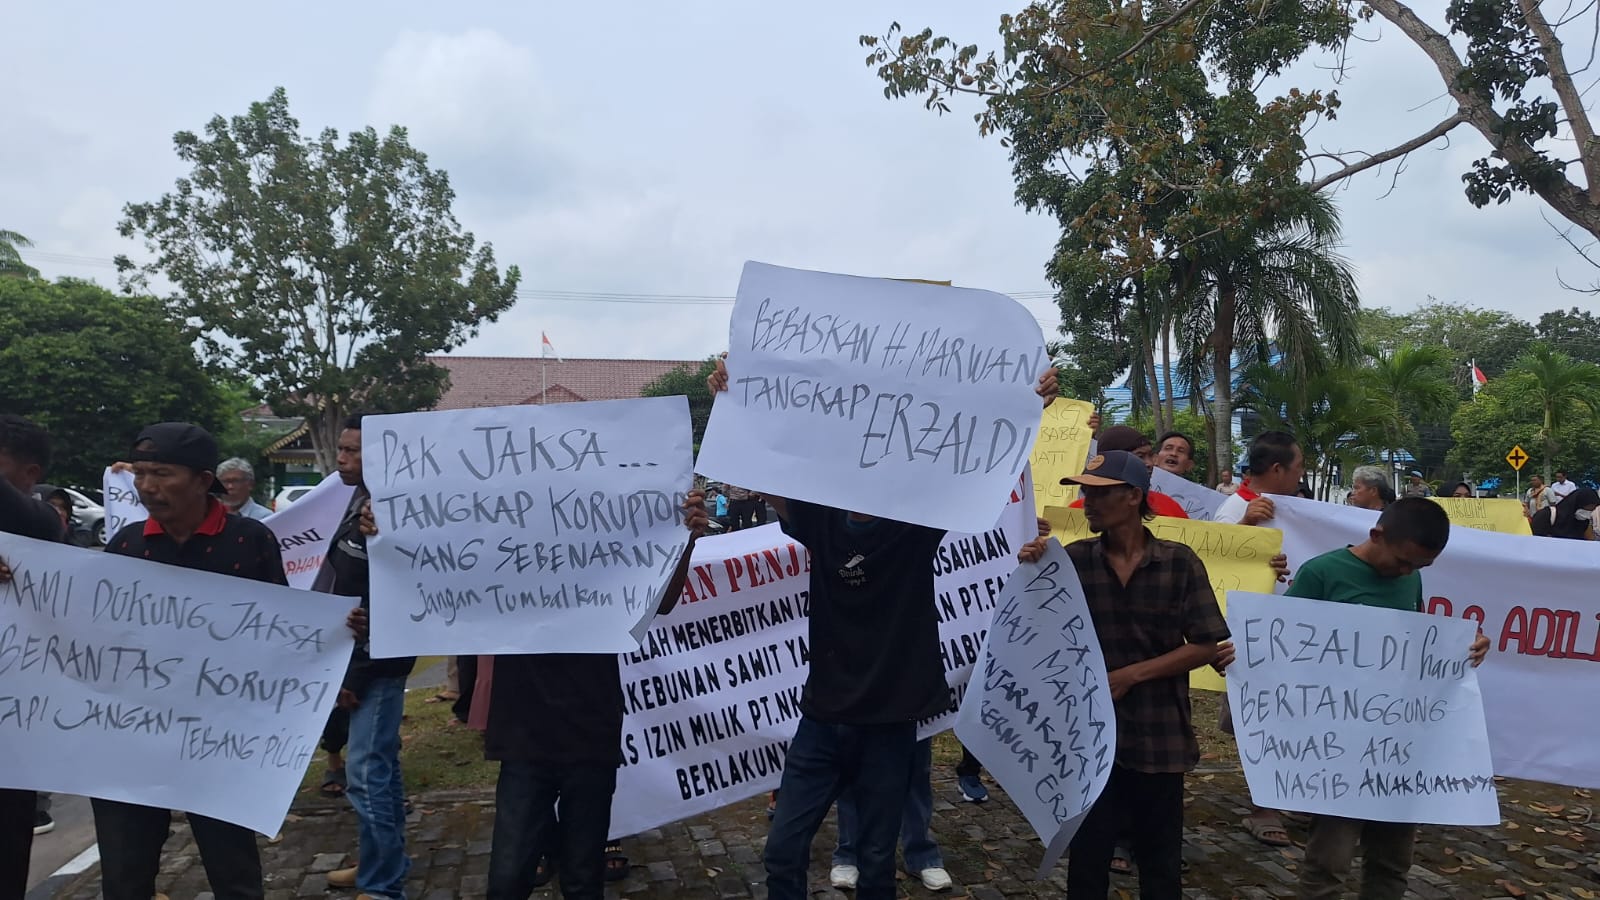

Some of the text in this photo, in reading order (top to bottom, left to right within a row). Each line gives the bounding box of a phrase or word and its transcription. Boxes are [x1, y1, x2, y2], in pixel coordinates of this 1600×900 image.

[751, 297, 880, 365] BEBASKAN
[737, 376, 1031, 476] TANGKAP ERZALDI
[382, 429, 442, 488] PAK
[377, 490, 534, 531] TANGKAP
[280, 527, 324, 552] ANI
[395, 538, 485, 573] YANG
[4, 555, 325, 652] KAMI DUKUNG JAKSA
[410, 583, 481, 626] jangan
[672, 596, 794, 651] MENERBITKAN
[0, 623, 331, 714] BERANTAS KORUPSI
[622, 662, 721, 716] KEBUNAN
[724, 643, 781, 688] SAWIT
[1420, 625, 1471, 681] harus
[53, 699, 173, 736] JANGAN
[178, 717, 260, 760] TEBANG
[643, 719, 686, 759] IZIN
[689, 703, 745, 747] MILIK
[747, 684, 806, 730] PT.NK
[1241, 681, 1448, 727] BERTANGGUNG
[1246, 729, 1413, 765] JAWAB ATAS
